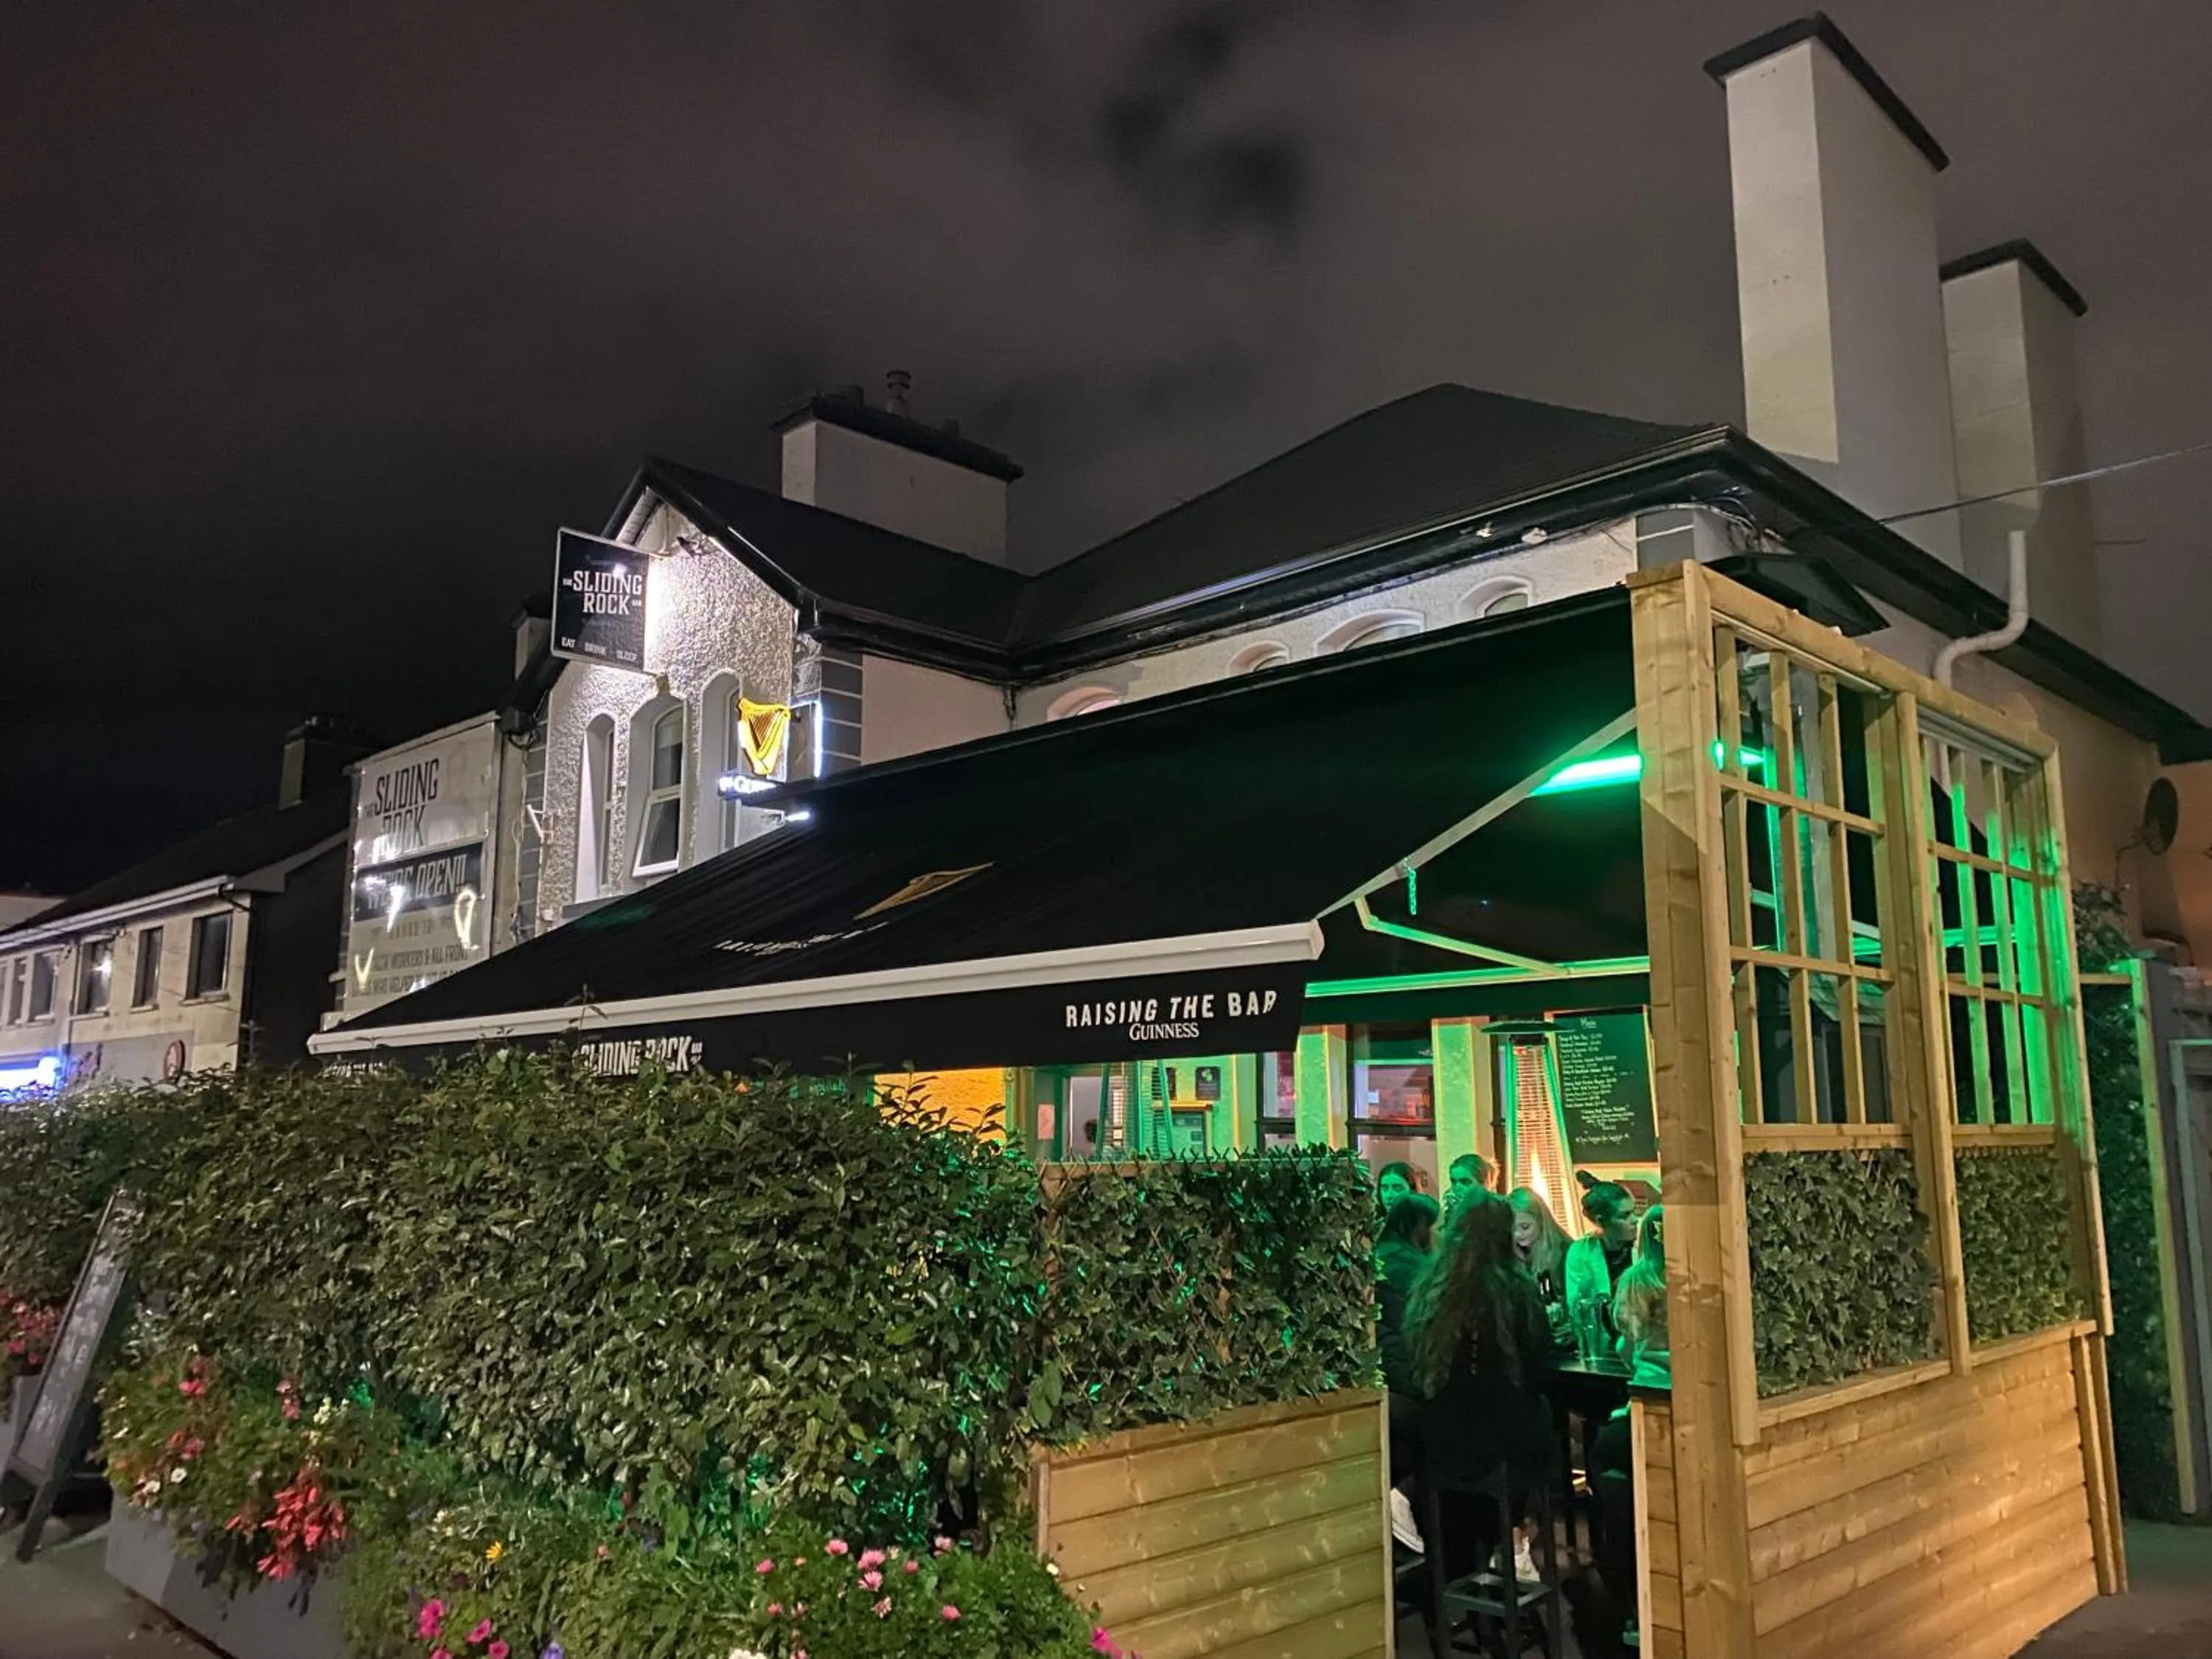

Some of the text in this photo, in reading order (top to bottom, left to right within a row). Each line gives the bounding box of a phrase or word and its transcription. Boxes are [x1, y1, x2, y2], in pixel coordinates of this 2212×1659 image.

[573, 571, 642, 595] SLIDING
[582, 593, 630, 615] ROCK
[561, 637, 576, 648] EAT
[374, 758, 439, 816] SLIDING
[381, 804, 425, 852] ROCK
[1065, 990, 1277, 1027] RAISING THE BAR
